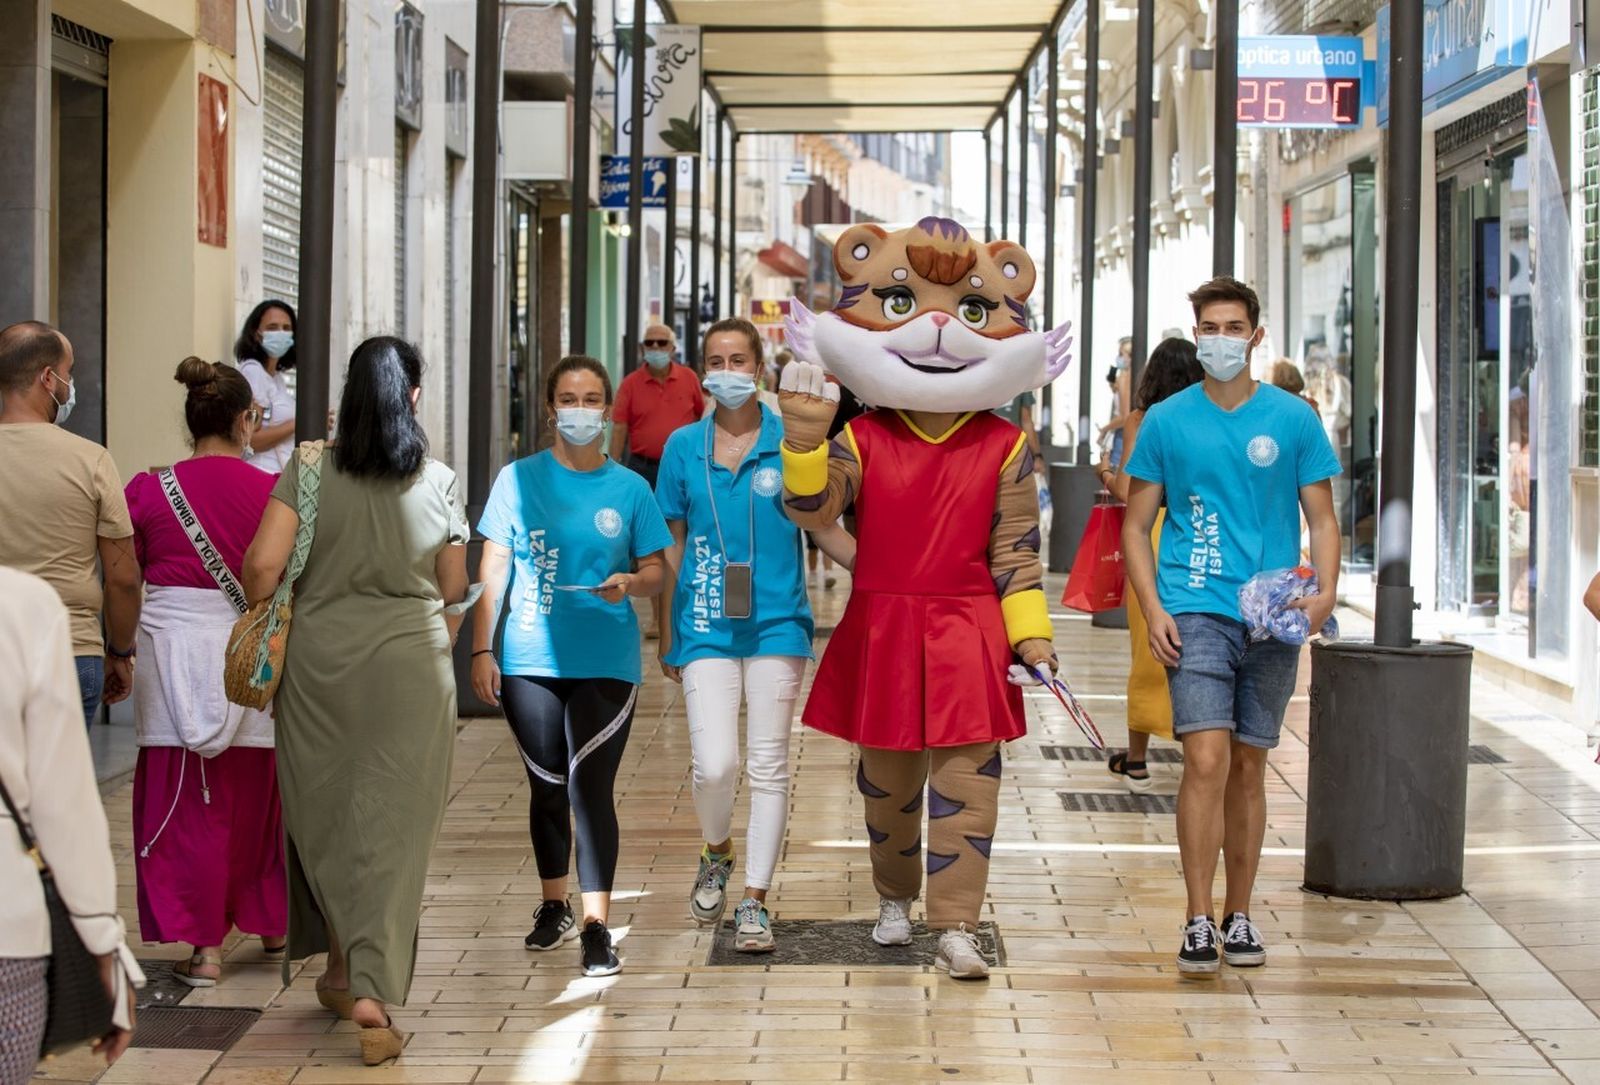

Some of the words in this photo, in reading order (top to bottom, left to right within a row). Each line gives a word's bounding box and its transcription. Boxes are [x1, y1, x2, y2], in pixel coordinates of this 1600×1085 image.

[1296, 45, 1356, 65] urbano
[1237, 81, 1285, 121] 26
[169, 486, 196, 528] BIMBA
[194, 532, 219, 567] LOLA
[1205, 512, 1222, 575] ESPAÑA
[219, 572, 248, 614] BIMBA
[541, 547, 559, 615] ESPAÑA
[708, 553, 722, 619] ESPAÑA
